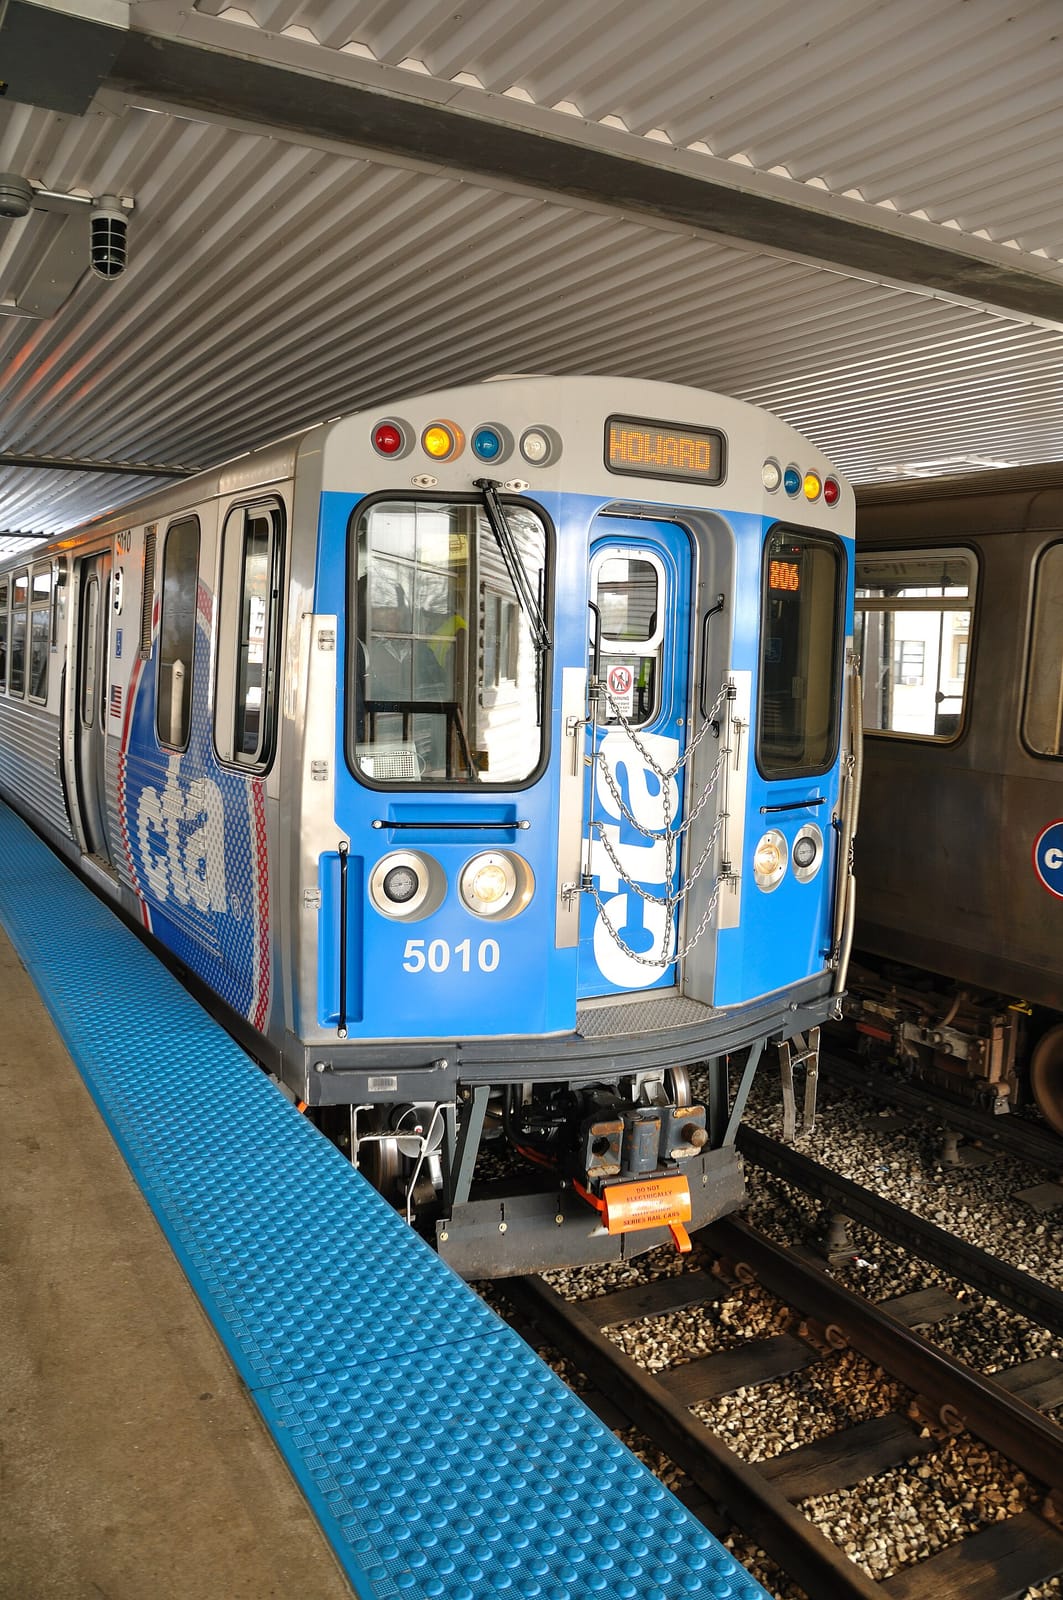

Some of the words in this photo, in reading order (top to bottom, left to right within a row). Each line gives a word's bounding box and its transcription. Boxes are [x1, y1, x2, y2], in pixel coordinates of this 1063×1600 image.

[609, 428, 711, 471] HOWARD
[582, 730, 680, 988] cta
[402, 938, 501, 974] 5010
[623, 1217, 646, 1226] SERIES
[647, 1214, 661, 1222] RAIL
[663, 1211, 680, 1219] CARS
